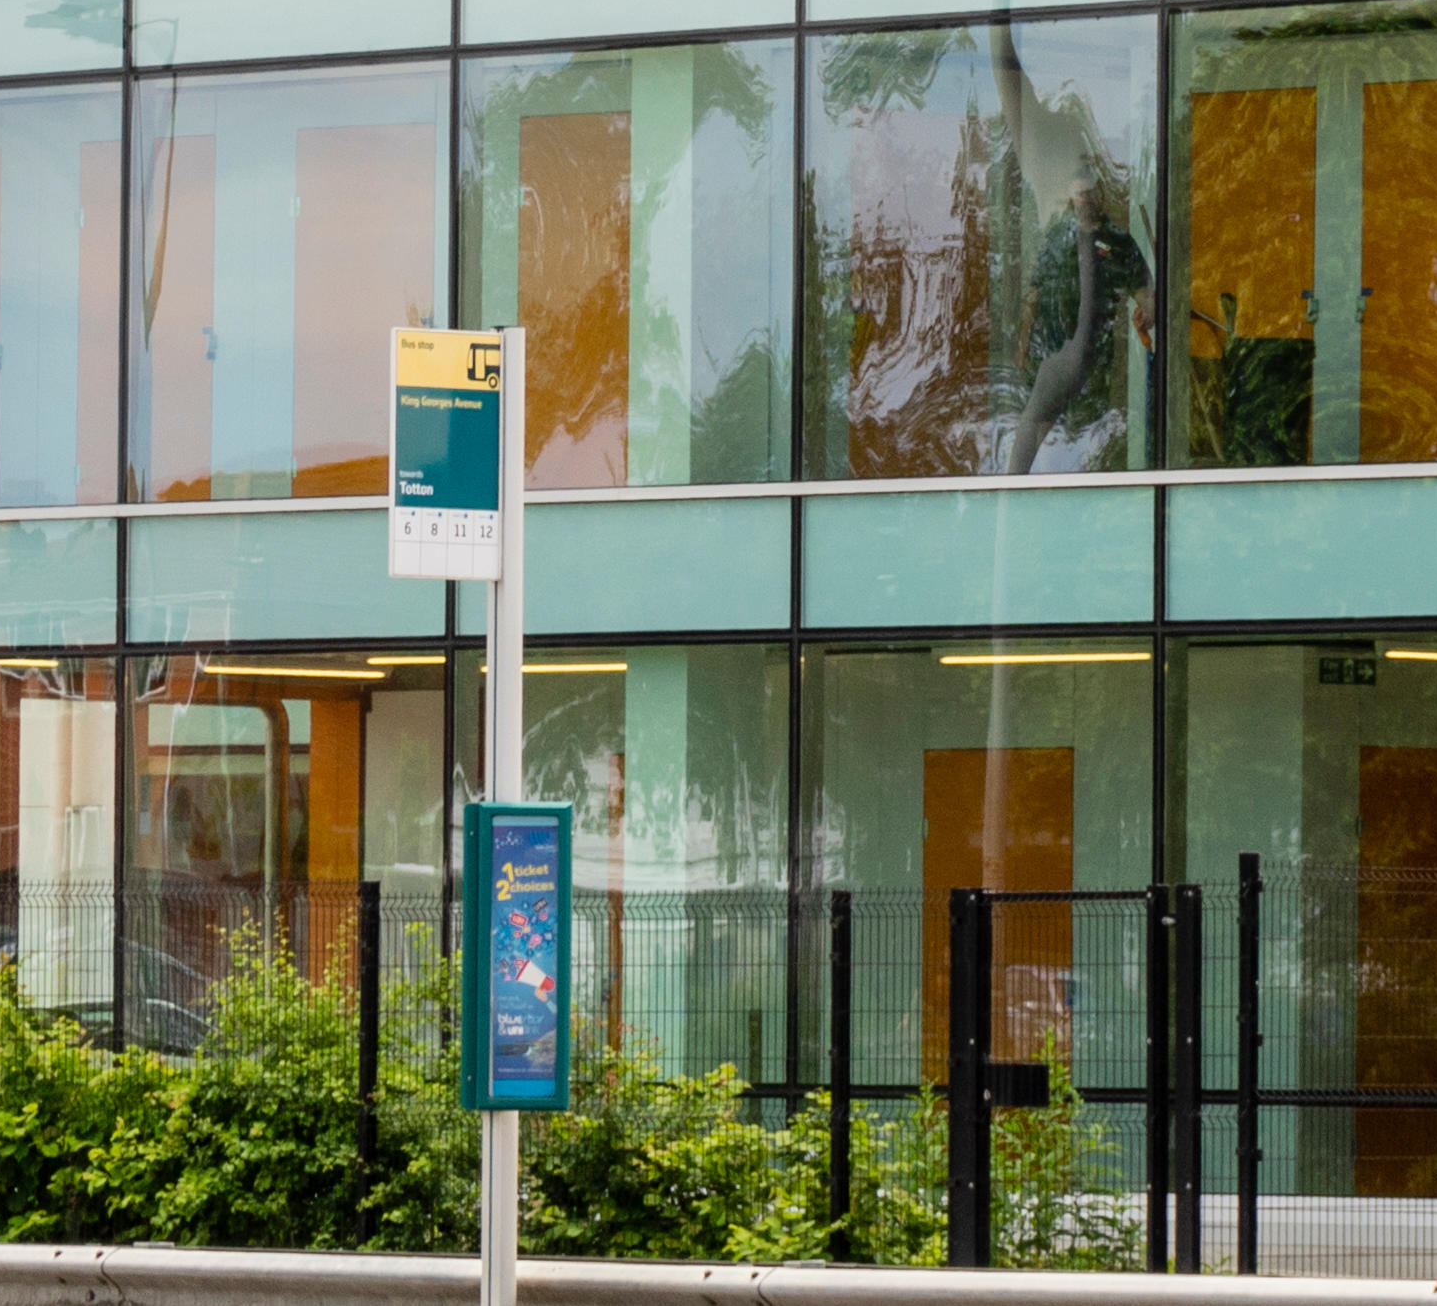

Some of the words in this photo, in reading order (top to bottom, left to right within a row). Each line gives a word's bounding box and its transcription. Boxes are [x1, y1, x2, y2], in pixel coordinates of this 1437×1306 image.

[401, 339, 416, 349] Bus
[417, 340, 434, 350] stop
[400, 395, 420, 408] King
[421, 396, 453, 410] Georges
[454, 397, 483, 409] Avenue
[399, 481, 434, 496] Totton
[404, 522, 412, 535] 6
[431, 523, 438, 536] 8
[454, 524, 466, 537] 11
[480, 525, 493, 538] 12
[501, 861, 514, 882] 1
[514, 864, 549, 877] ticket
[496, 879, 511, 901] 2
[509, 881, 555, 893] choices
